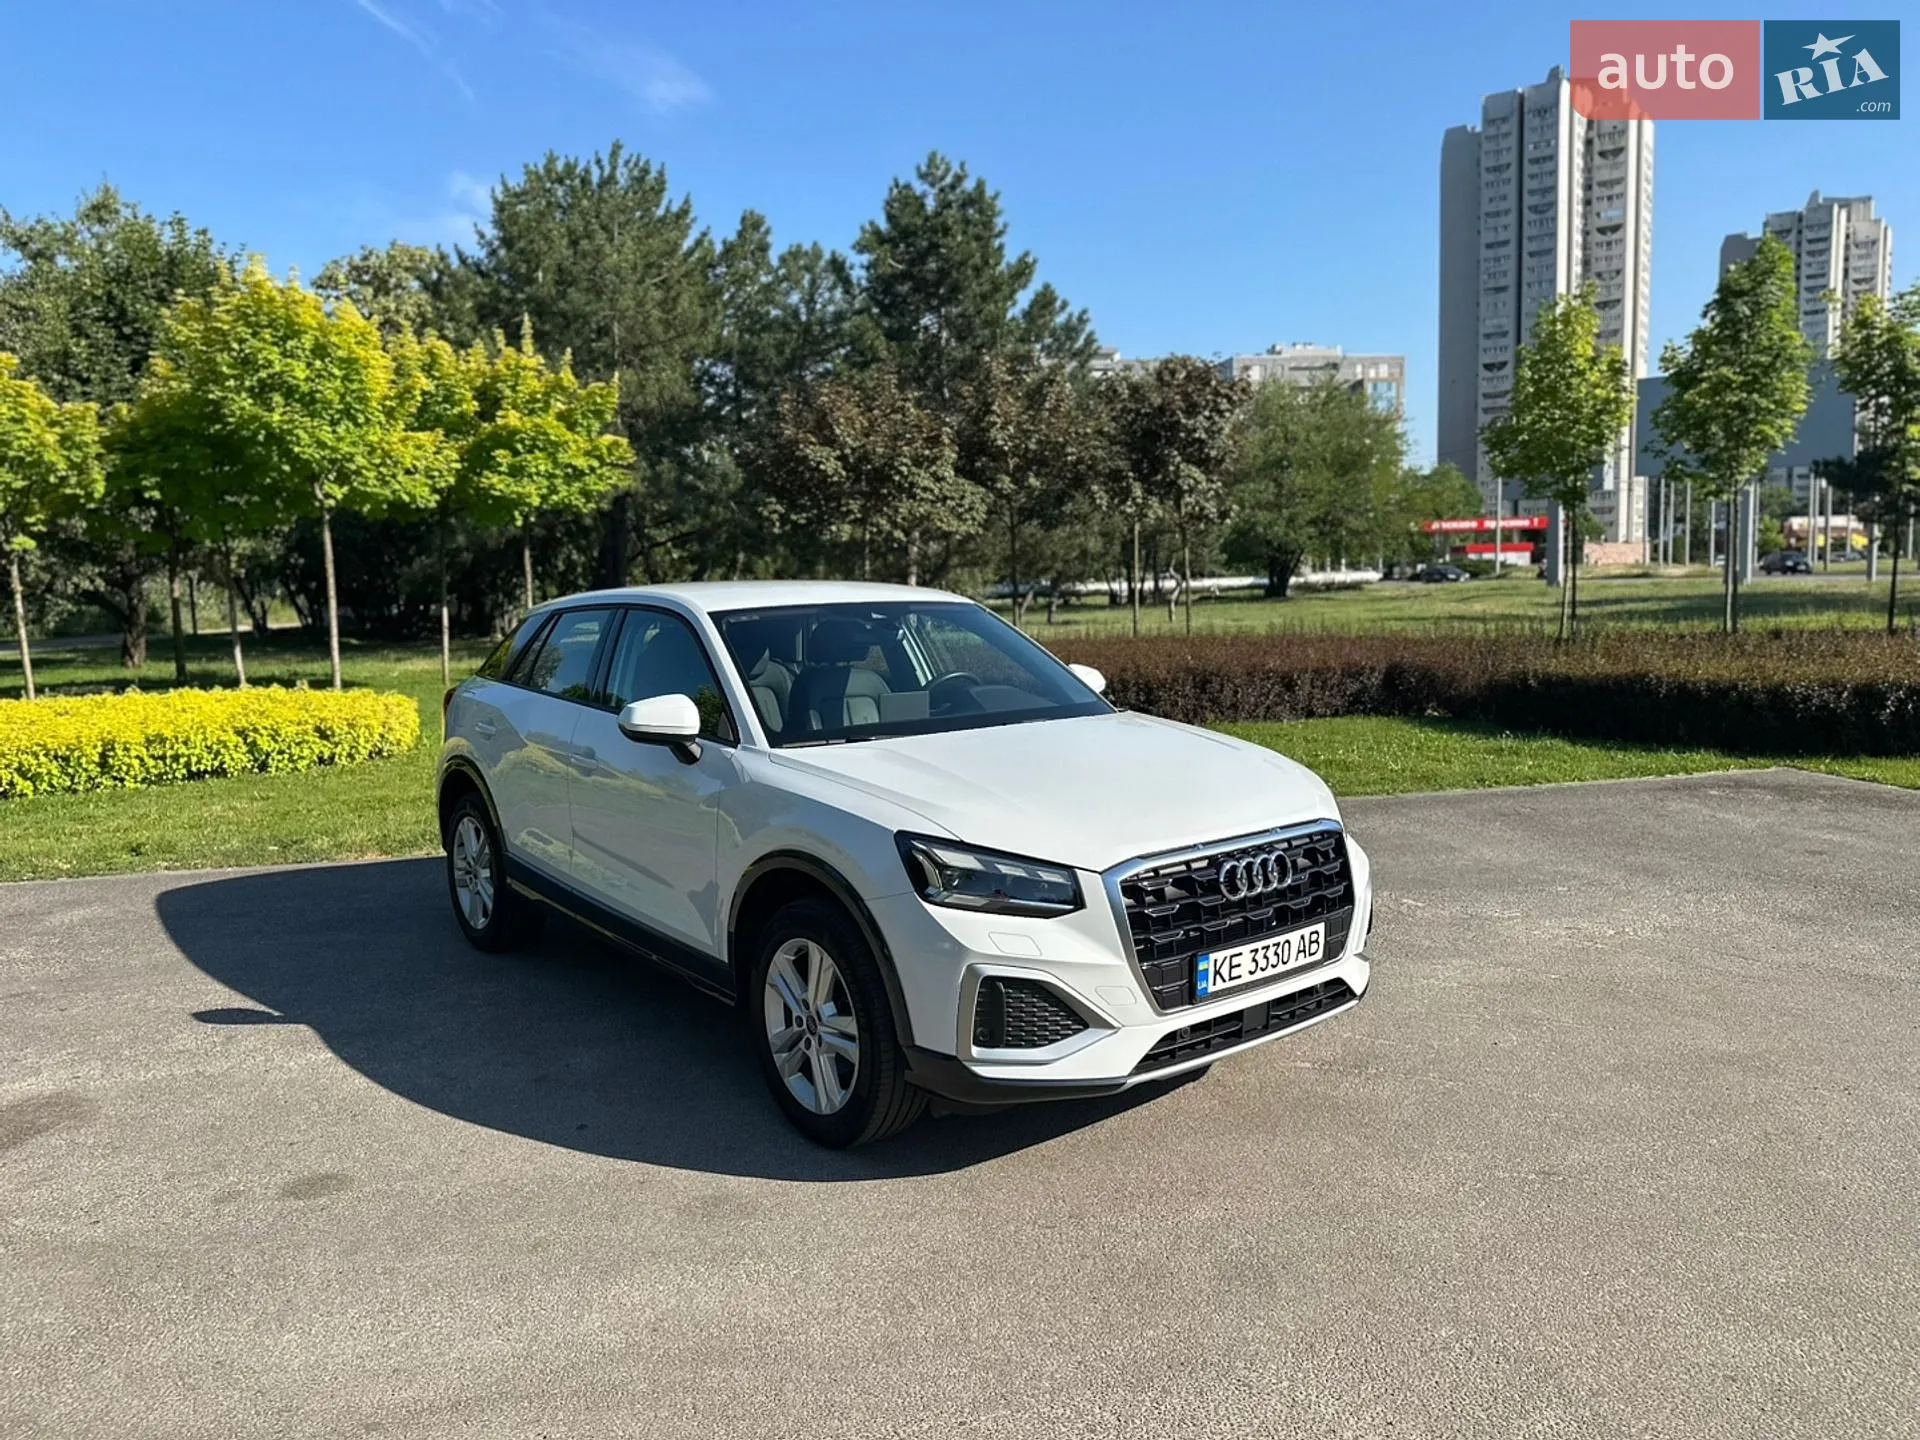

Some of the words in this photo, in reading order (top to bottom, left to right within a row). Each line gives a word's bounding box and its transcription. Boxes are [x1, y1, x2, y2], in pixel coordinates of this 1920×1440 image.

[1212, 952, 1243, 987] KE
[1248, 939, 1291, 976] 3330
[1295, 930, 1320, 962] AB
